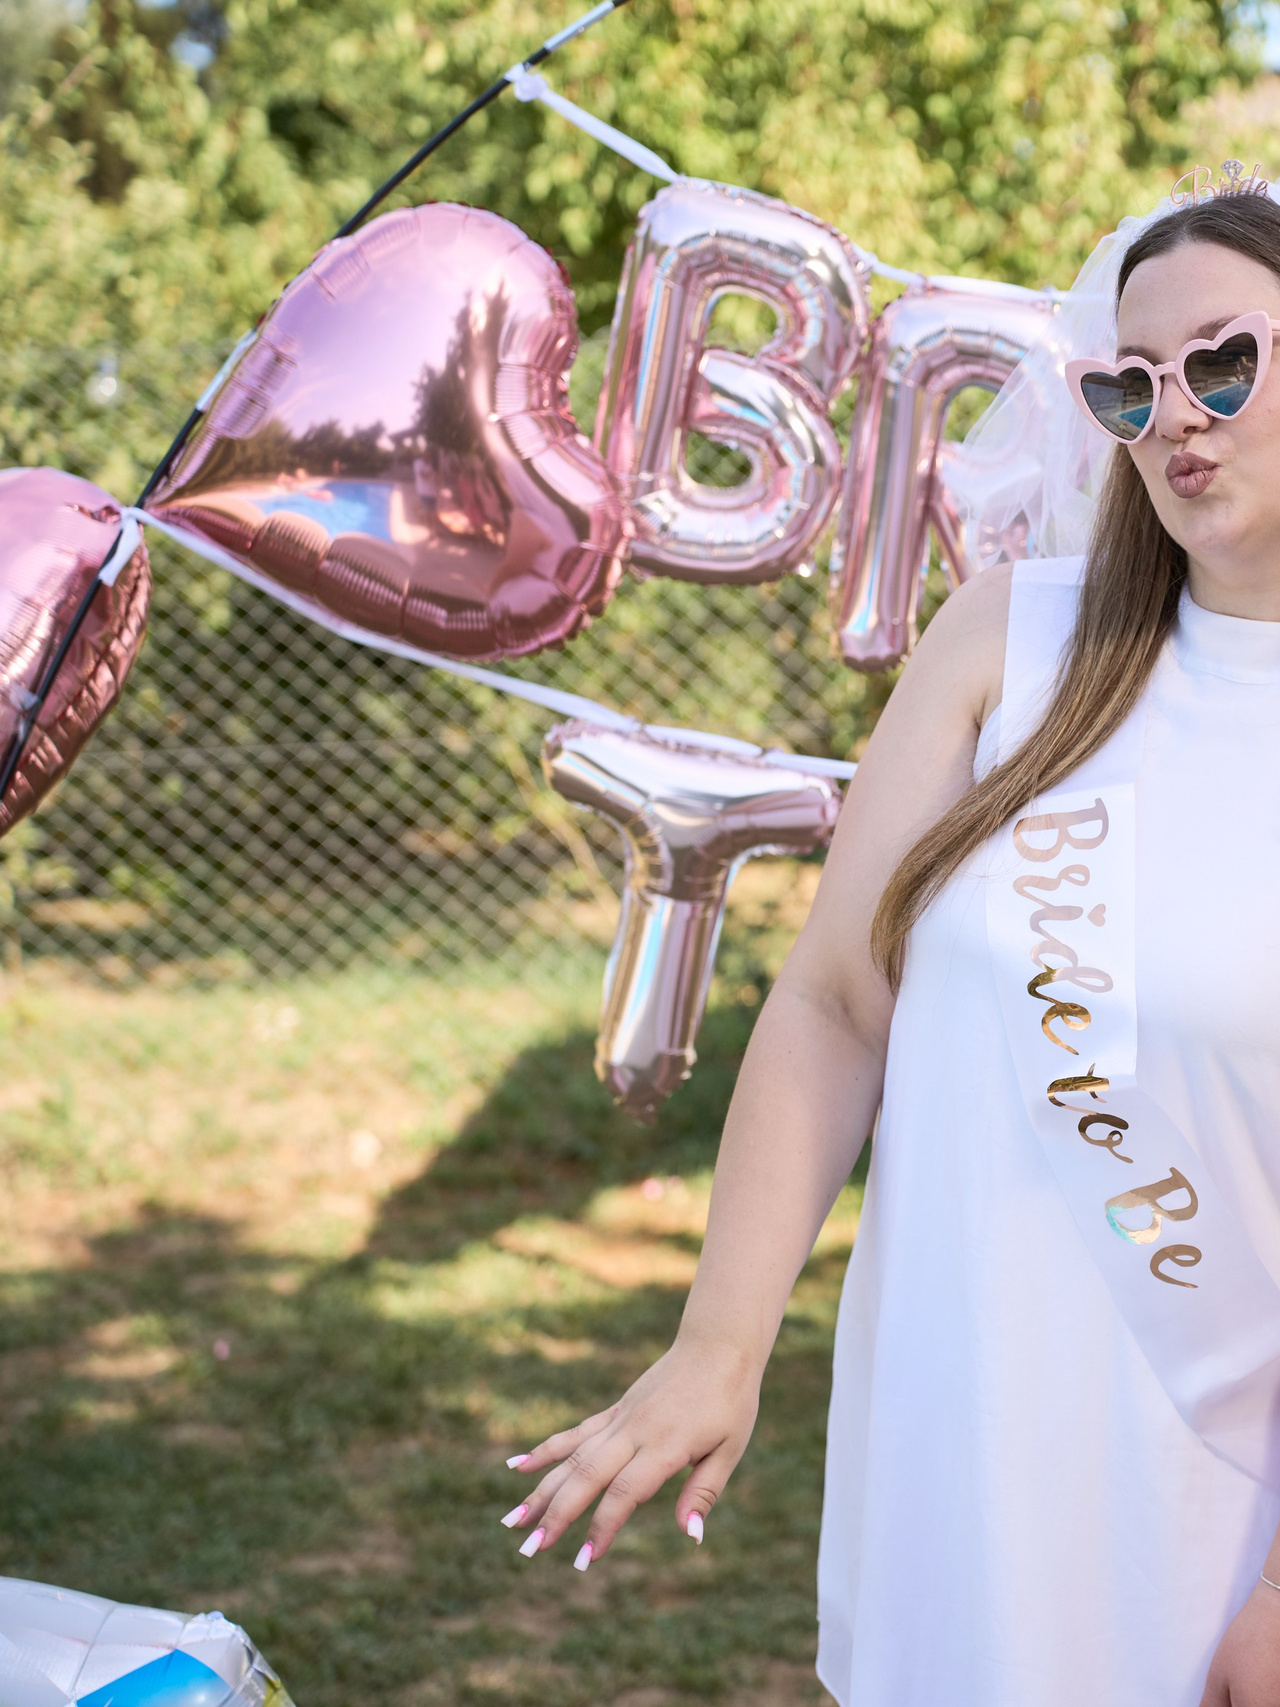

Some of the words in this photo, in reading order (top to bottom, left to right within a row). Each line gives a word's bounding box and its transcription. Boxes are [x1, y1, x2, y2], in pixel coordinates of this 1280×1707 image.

[1171, 160, 1269, 206] Bride
[1012, 797, 1114, 1056] Bride
[1046, 1062, 1134, 1164] to
[1104, 1166, 1203, 1290] Be
